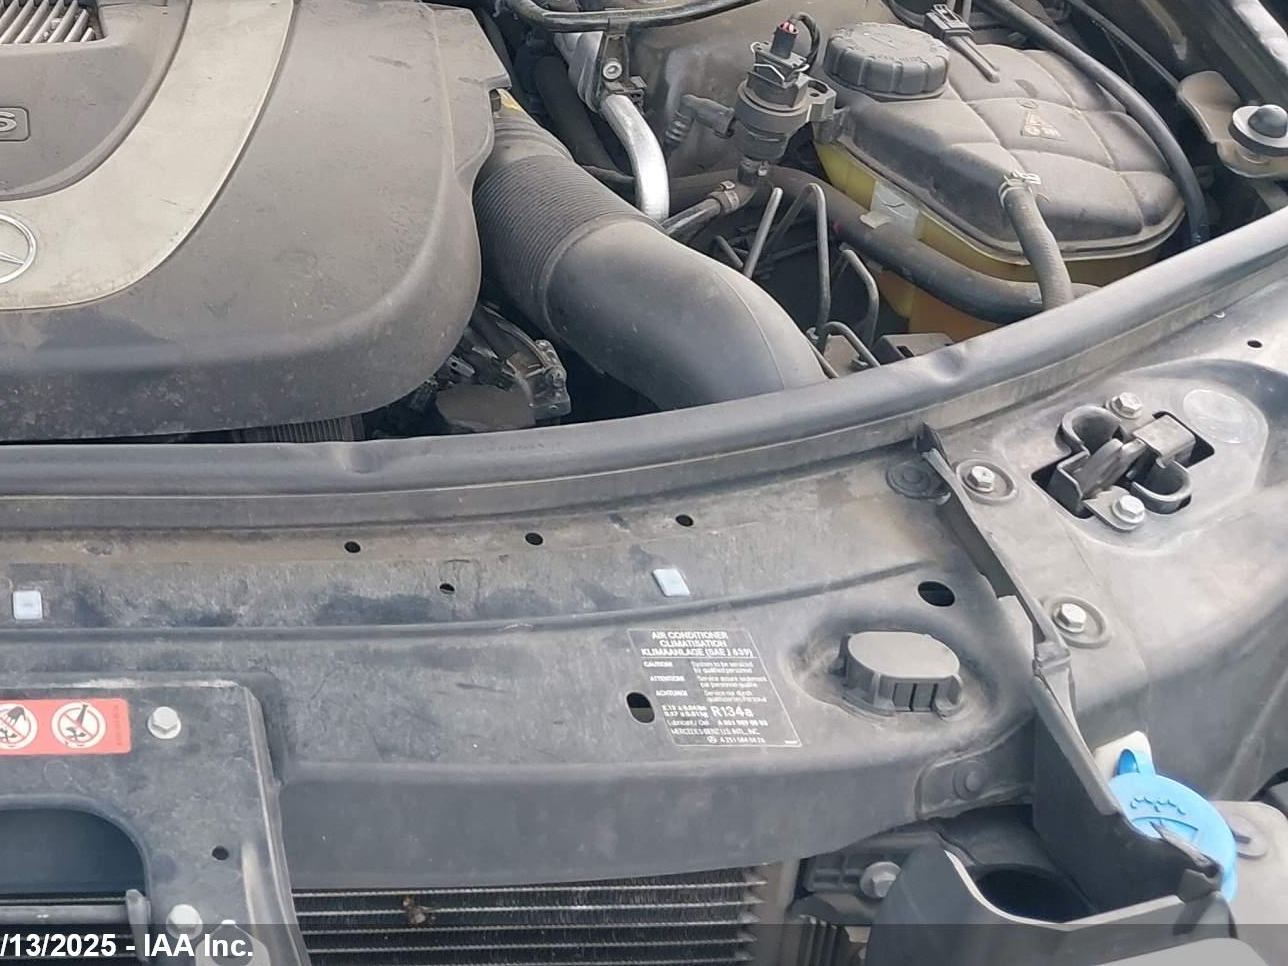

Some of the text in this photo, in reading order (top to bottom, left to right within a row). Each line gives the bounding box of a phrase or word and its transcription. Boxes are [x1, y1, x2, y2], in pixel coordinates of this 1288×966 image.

[652, 631, 728, 639] AIR CONDITIONER
[659, 639, 727, 647] CLIMATISATION
[641, 648, 705, 656] KLIMAANLAGE
[710, 706, 754, 717] R134a
